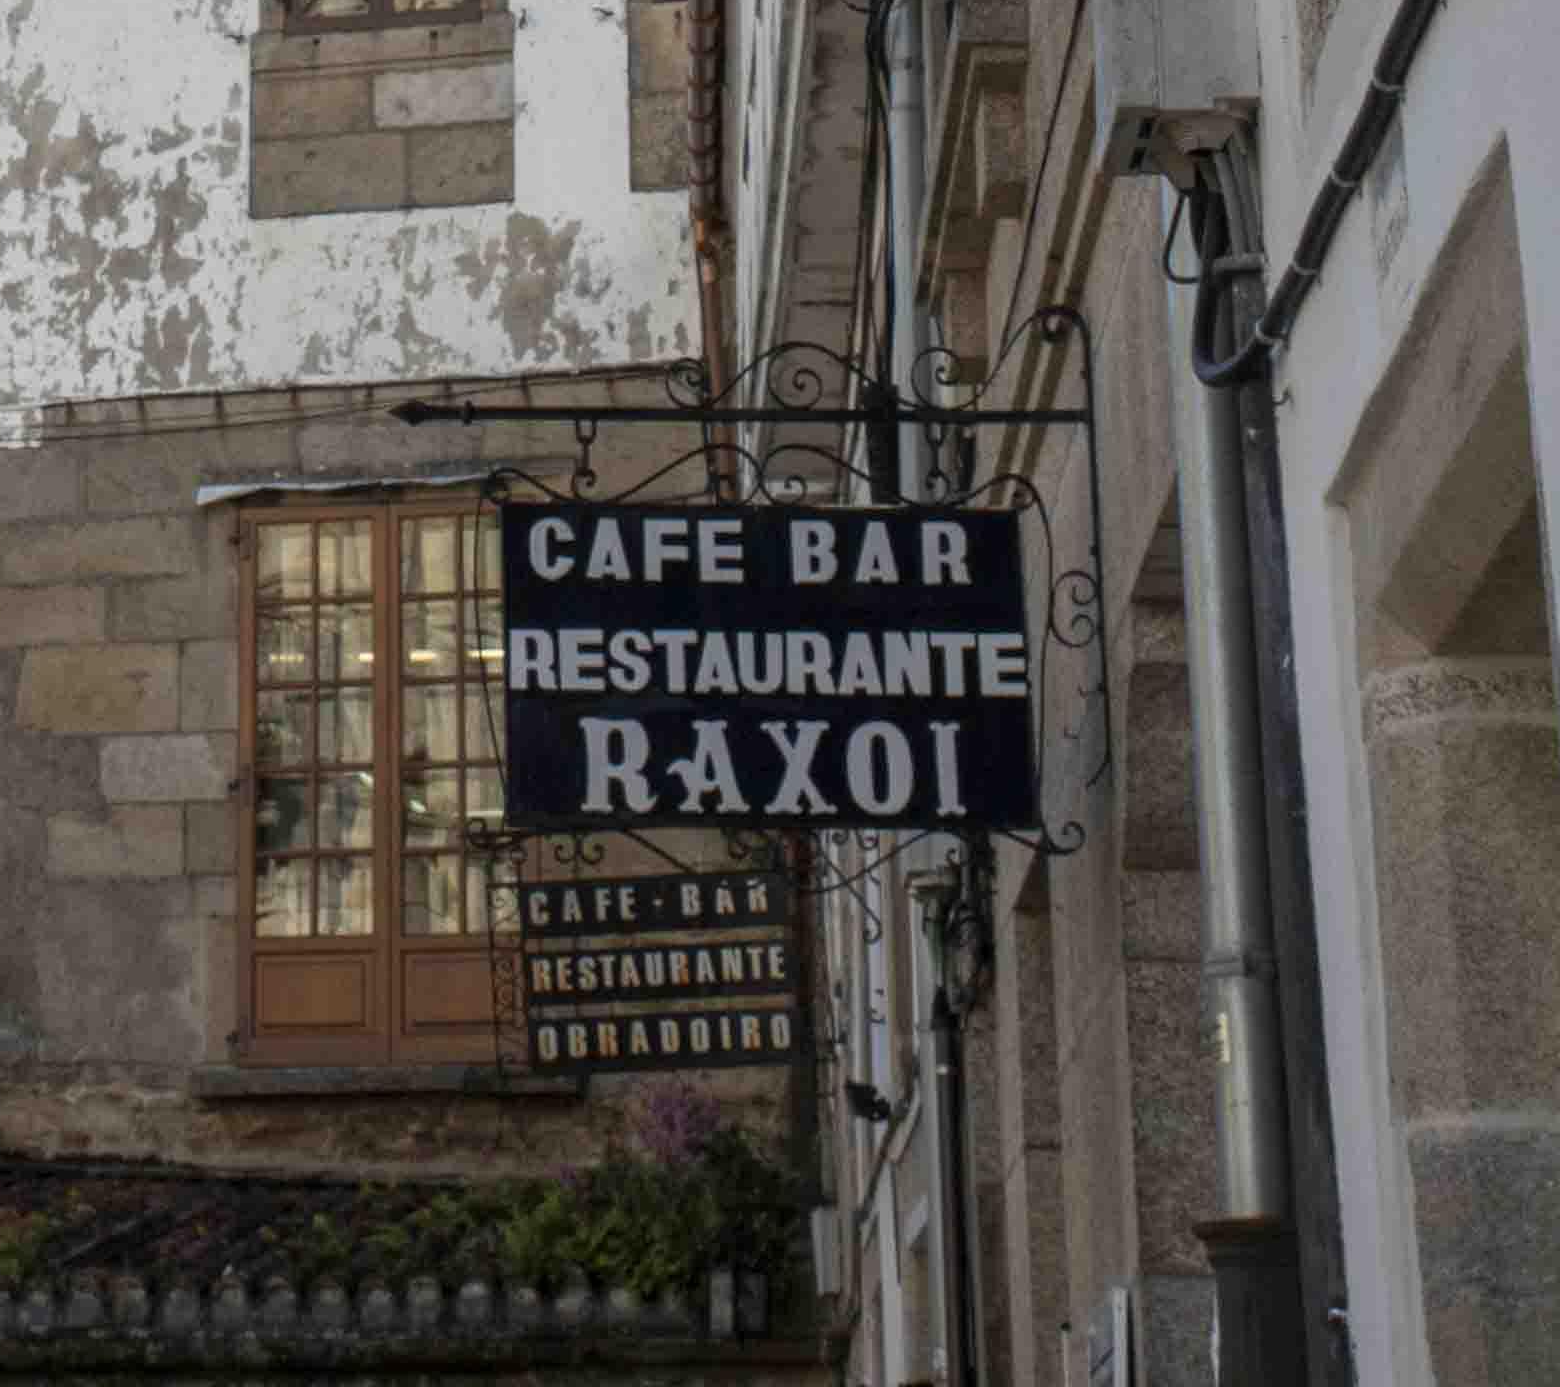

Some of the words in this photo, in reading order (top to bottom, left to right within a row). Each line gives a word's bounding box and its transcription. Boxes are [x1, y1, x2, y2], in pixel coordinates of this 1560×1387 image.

[528, 516, 744, 583] CAFE
[790, 519, 972, 585] BAR
[509, 627, 1028, 697] RESTAURANTE
[580, 716, 968, 818] RAXOI
[528, 885, 637, 926] CAFE
[680, 877, 769, 917] BAR
[532, 945, 786, 993] RESTAURANTE
[536, 1013, 792, 1063] OBRADOIRO
